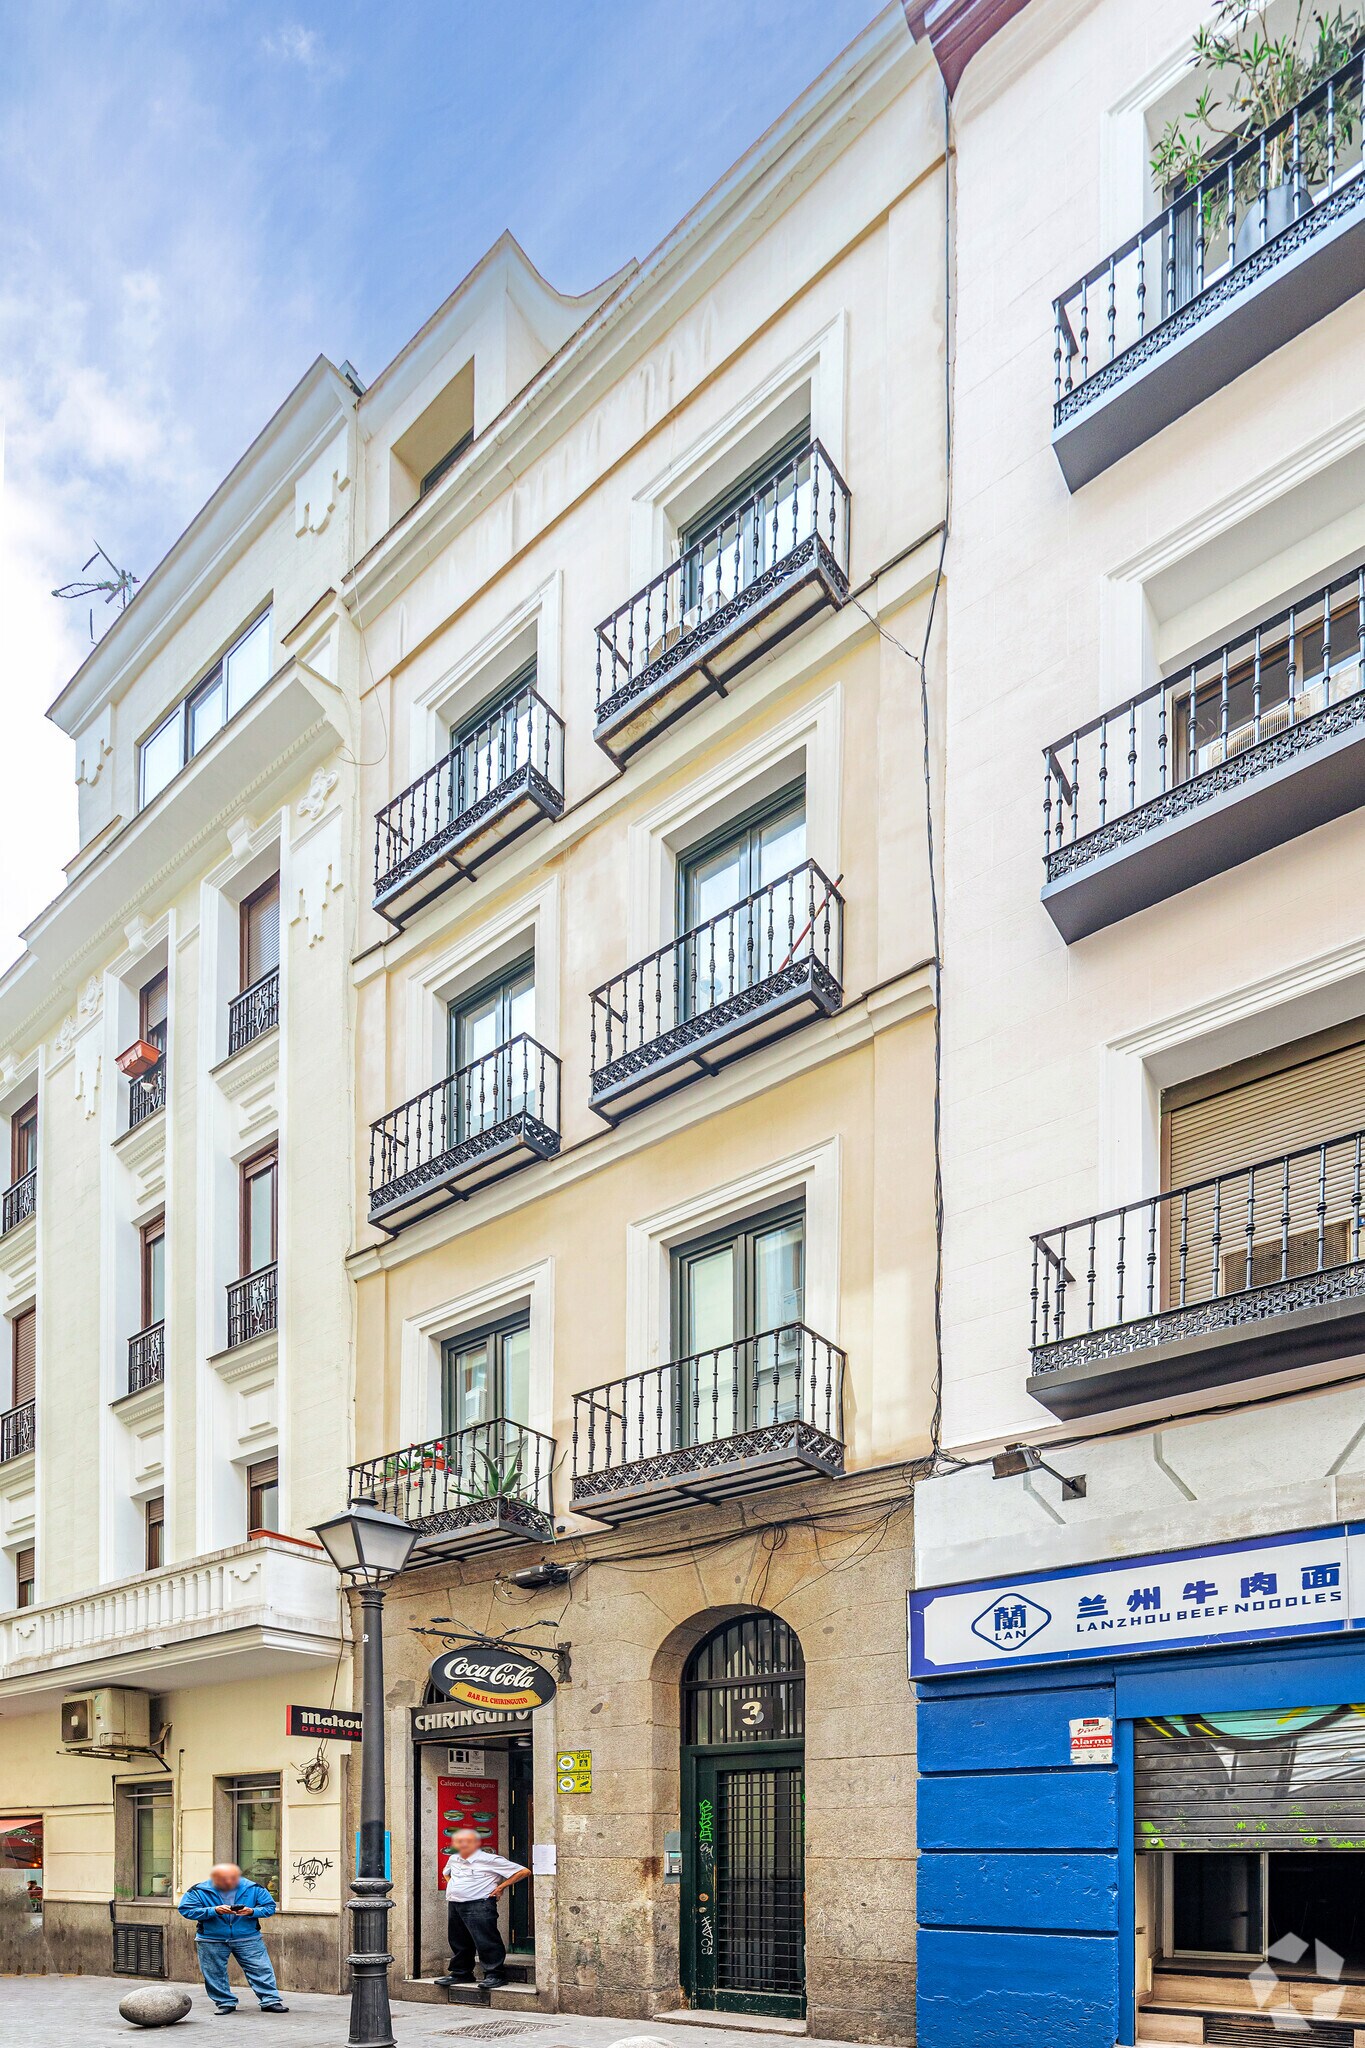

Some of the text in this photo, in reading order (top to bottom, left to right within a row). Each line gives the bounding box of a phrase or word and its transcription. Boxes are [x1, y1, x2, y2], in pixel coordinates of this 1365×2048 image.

[1076, 1562, 1341, 1619] 兰州牛肉面
[1076, 1591, 1342, 1633] LANZHOU BEEF NOODLES
[994, 1629, 1027, 1641] LAN
[443, 1656, 540, 1689] Coca-Cola
[466, 1691, 528, 1706] BAR EL CHIRINGUITO
[300, 1711, 363, 1730] Mahou
[741, 1701, 765, 1725] 3
[301, 1725, 363, 1737] DESDE 189
